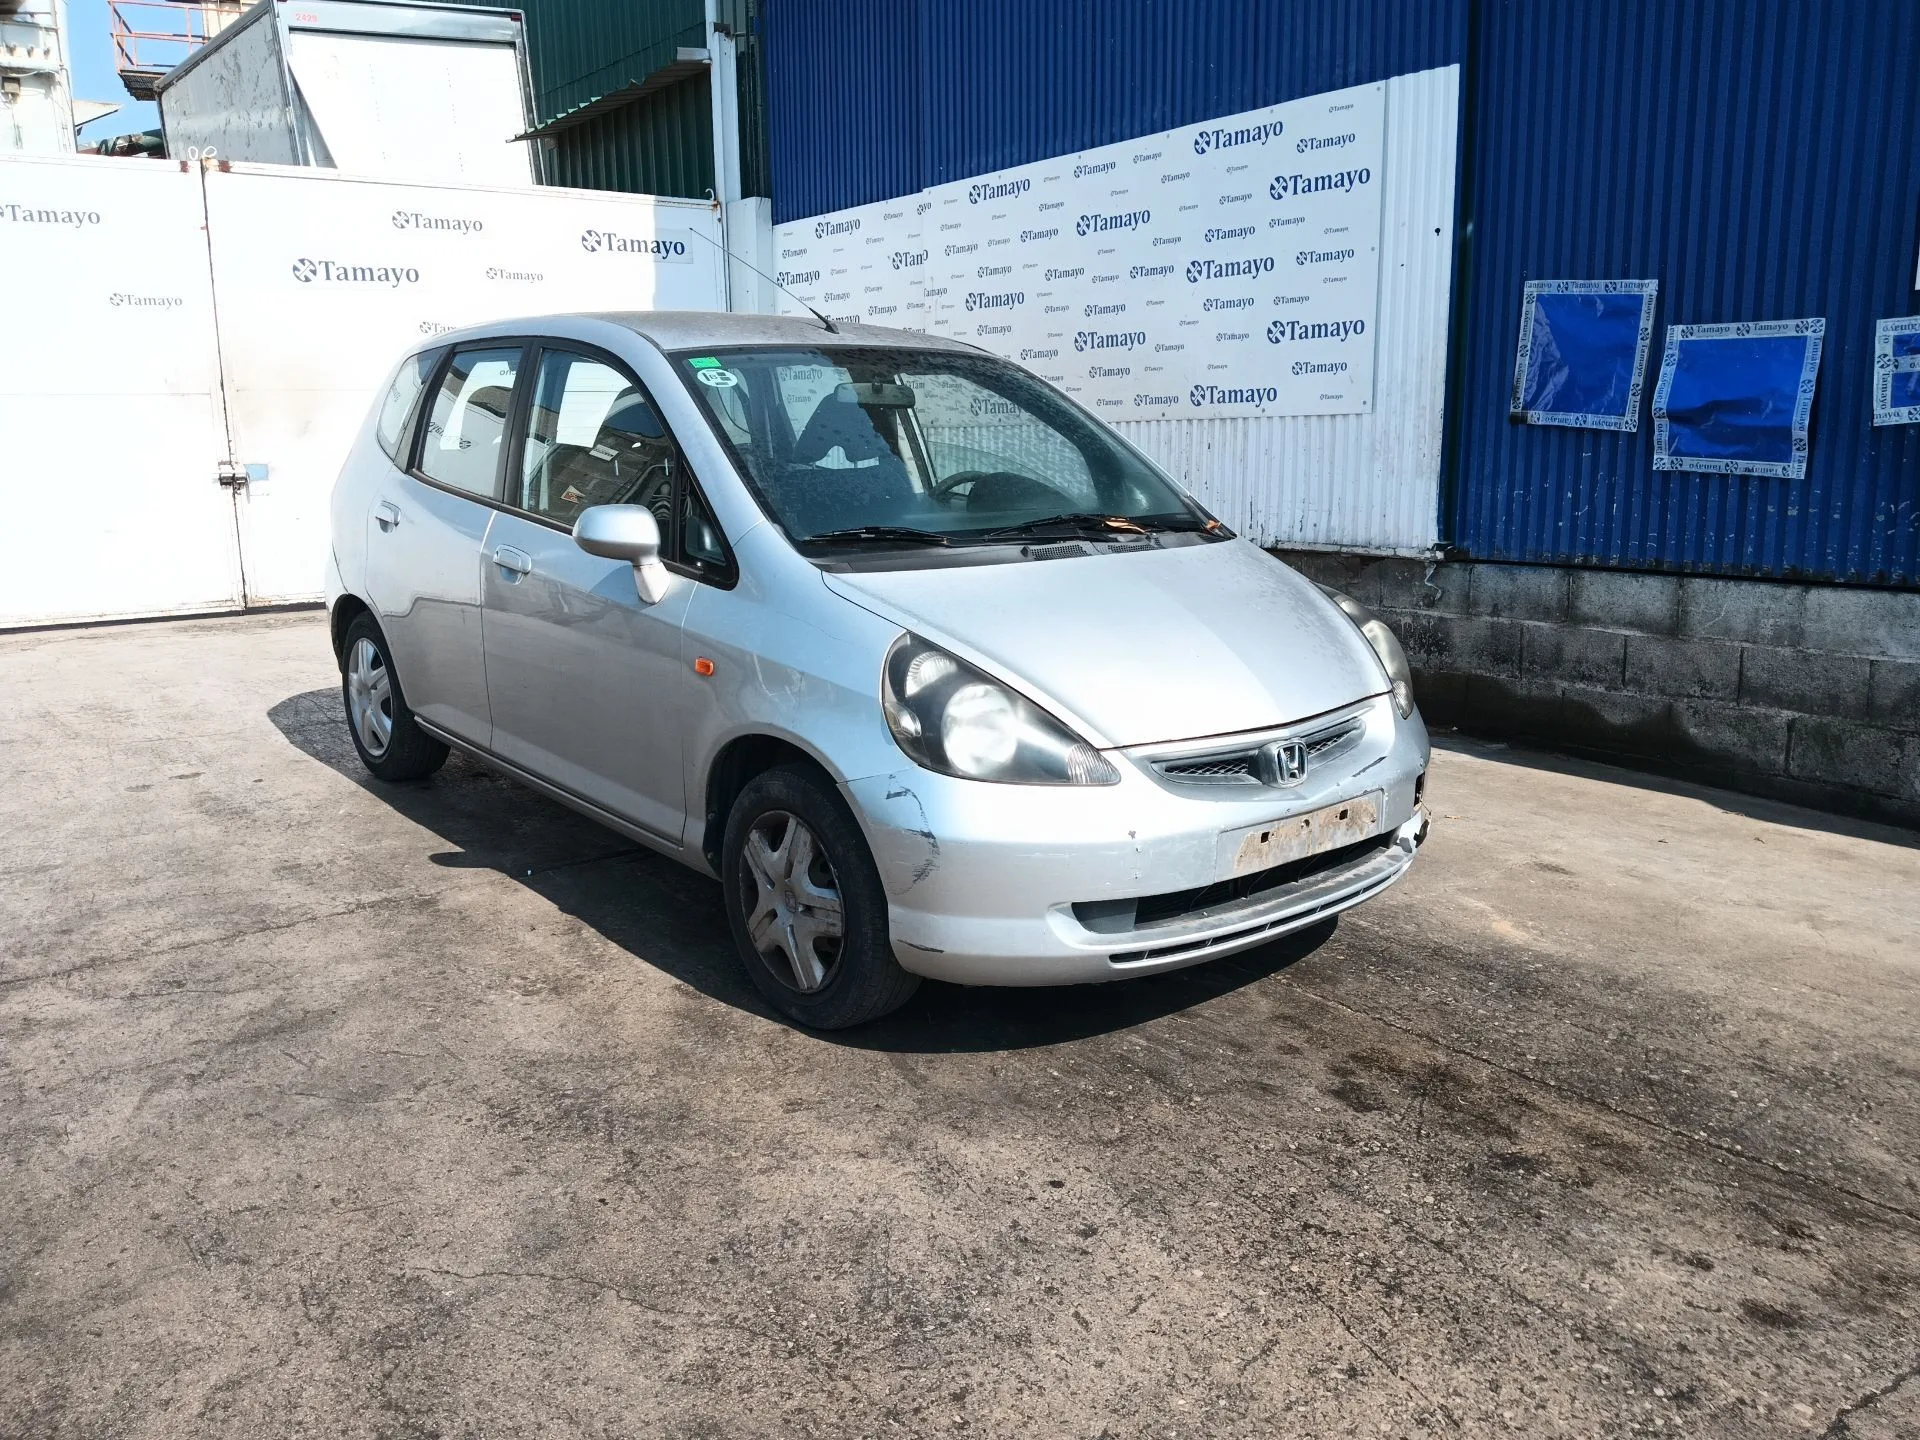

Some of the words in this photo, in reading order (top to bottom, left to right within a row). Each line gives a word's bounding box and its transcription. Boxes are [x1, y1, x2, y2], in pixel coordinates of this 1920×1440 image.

[1212, 121, 1283, 149] Tamayo
[1309, 133, 1355, 150] Tamayo
[1082, 162, 1115, 175] Tamayo
[1290, 168, 1370, 195] Tamayo
[981, 179, 1030, 200] Tamayo
[1225, 193, 1252, 203] Tamayo
[5, 204, 101, 229] Tamayo
[1091, 210, 1150, 232] Tamayo
[1276, 217, 1305, 226] Tamayo
[410, 213, 484, 236] Tamayo
[825, 219, 860, 236] Tamayo
[1028, 228, 1058, 240] Tamayo
[1215, 226, 1255, 240] Tamayo
[603, 232, 685, 259] Tamayo
[951, 244, 978, 254] Tamayo
[1308, 249, 1354, 263] Tamayo
[318, 260, 419, 288] Tamayo
[985, 266, 1011, 276] Tamayo
[1053, 268, 1084, 279] Tamayo
[1139, 265, 1174, 277] Tamayo
[1203, 257, 1274, 279] Tamayo
[498, 268, 544, 283] Tamayo
[785, 270, 820, 285] Tamayo
[1571, 281, 1600, 289] Tamayo
[1620, 281, 1650, 290] Tamayo
[124, 294, 183, 309] Tamayo
[977, 292, 1024, 310] Tamayo
[1213, 298, 1254, 310] Tamayo
[1281, 296, 1309, 304] Tamayo
[1094, 304, 1125, 315] Tamayo
[984, 325, 1011, 336] Tamayo
[1287, 320, 1365, 342] Tamayo
[1695, 325, 1730, 334] Tamayo
[1752, 322, 1789, 332] Tamayo
[1088, 332, 1146, 351] Tamayo
[1223, 333, 1249, 341] Tamayo
[1027, 349, 1058, 360] Tamayo
[788, 367, 823, 383] Tamayo
[1097, 367, 1130, 378] Tamayo
[1303, 362, 1347, 375] Tamayo
[1207, 386, 1277, 408] Tamayo
[1879, 370, 1890, 410] Tamayo
[1143, 395, 1178, 407] Tamayo
